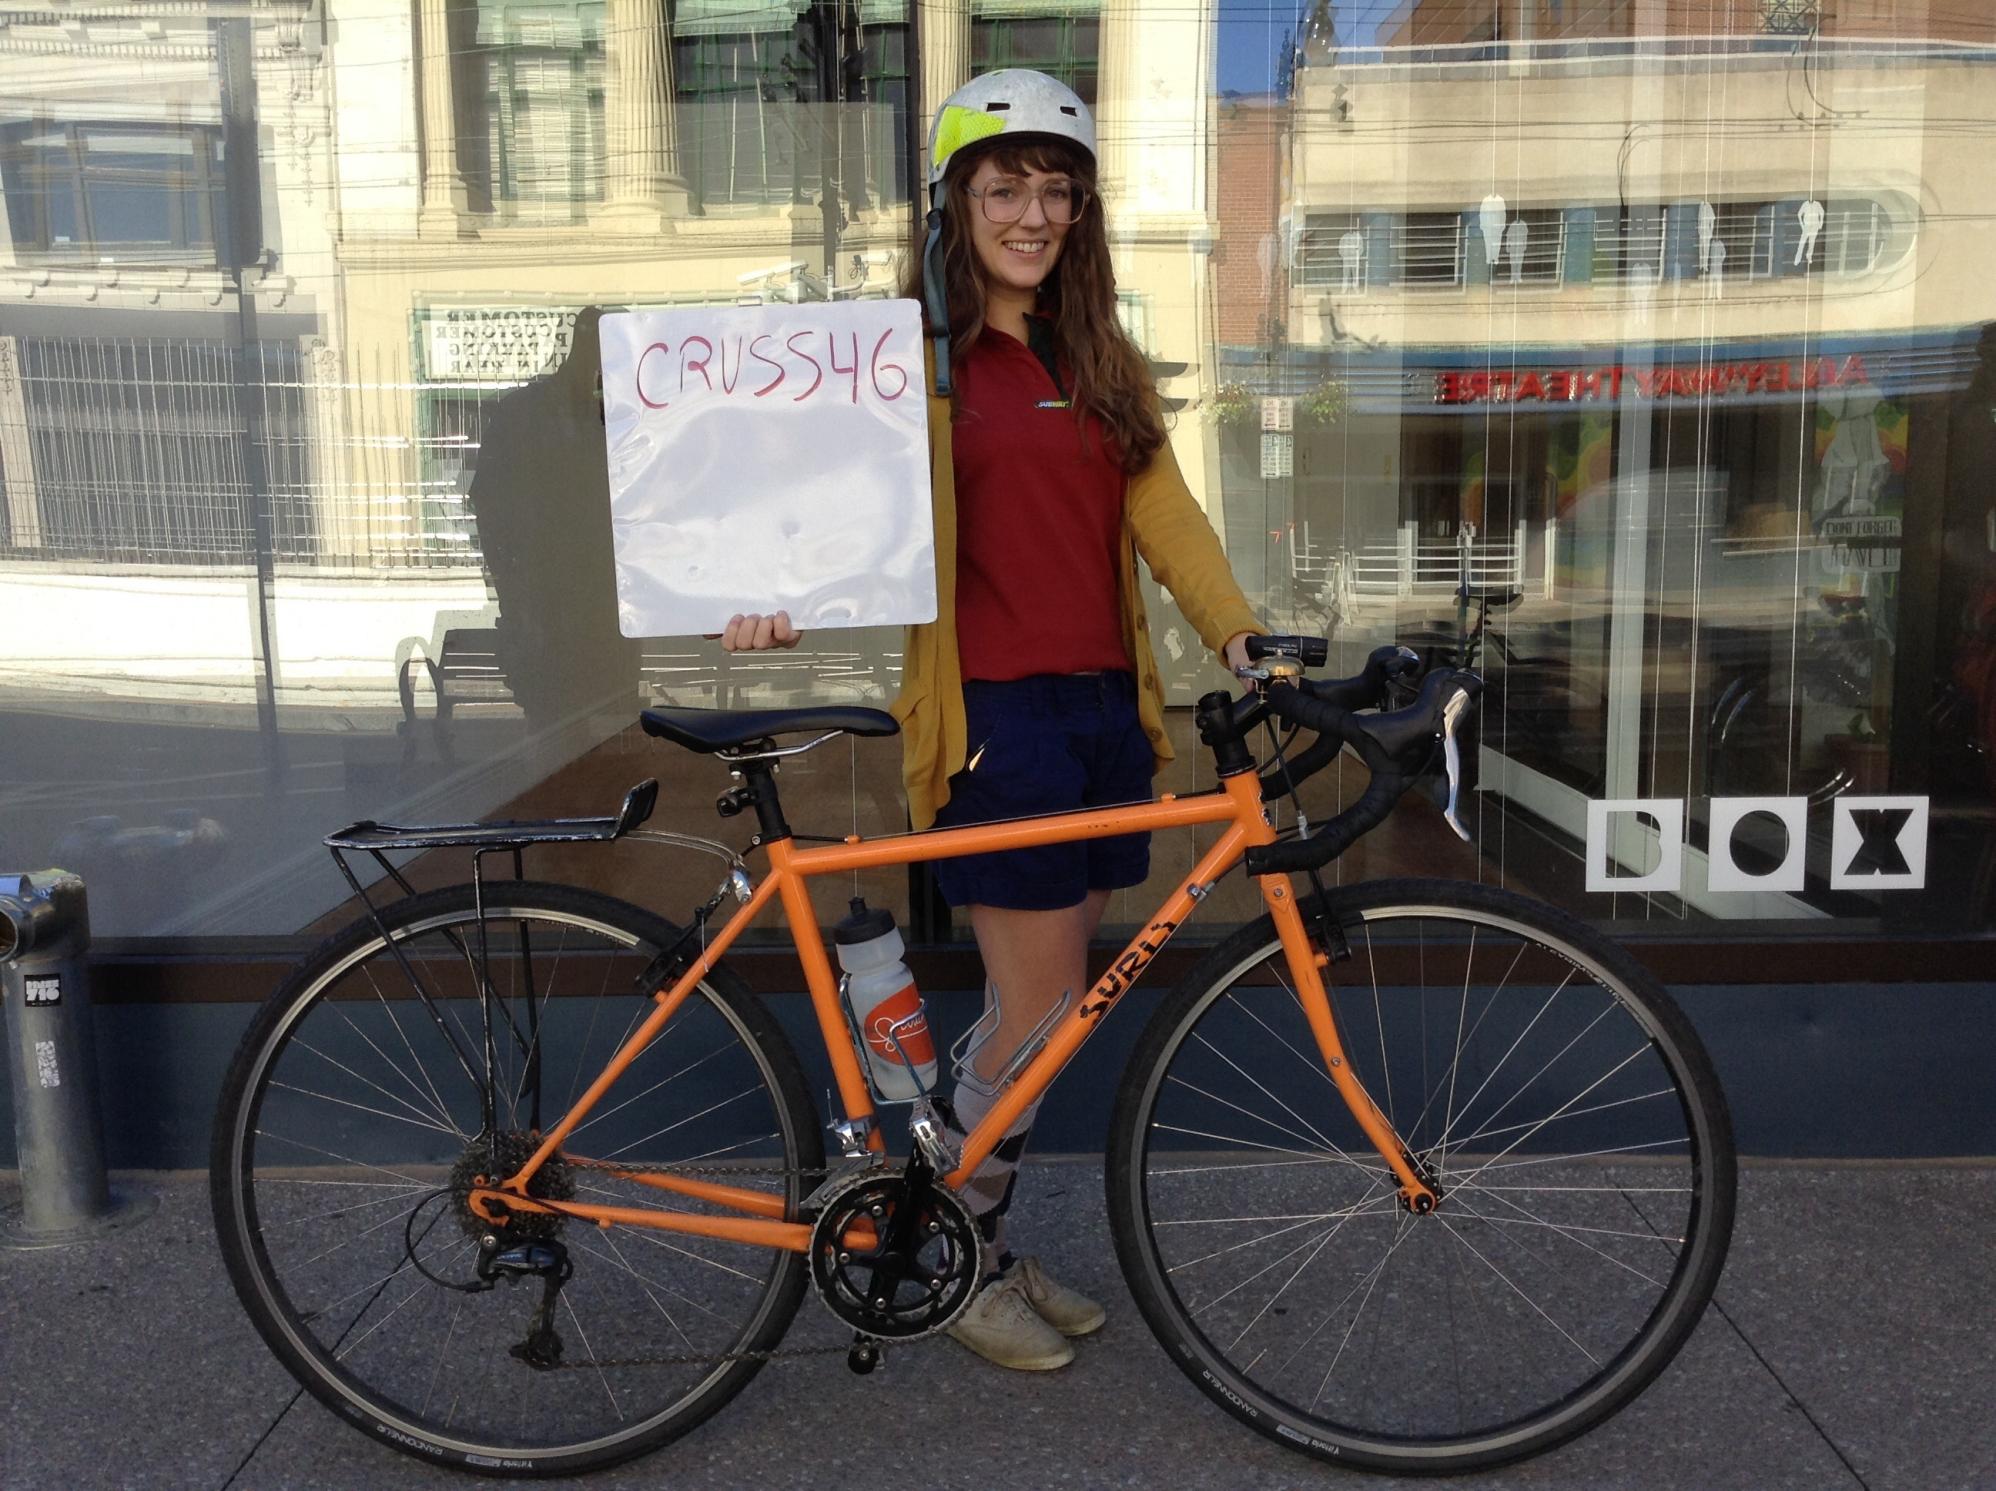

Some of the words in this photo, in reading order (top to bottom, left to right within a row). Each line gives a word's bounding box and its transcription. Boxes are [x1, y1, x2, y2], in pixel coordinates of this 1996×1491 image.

[637, 327, 908, 410] CRUSS46
[1604, 808, 1914, 879] BOX
[1202, 1368, 1258, 1418] RANDONNEUR
